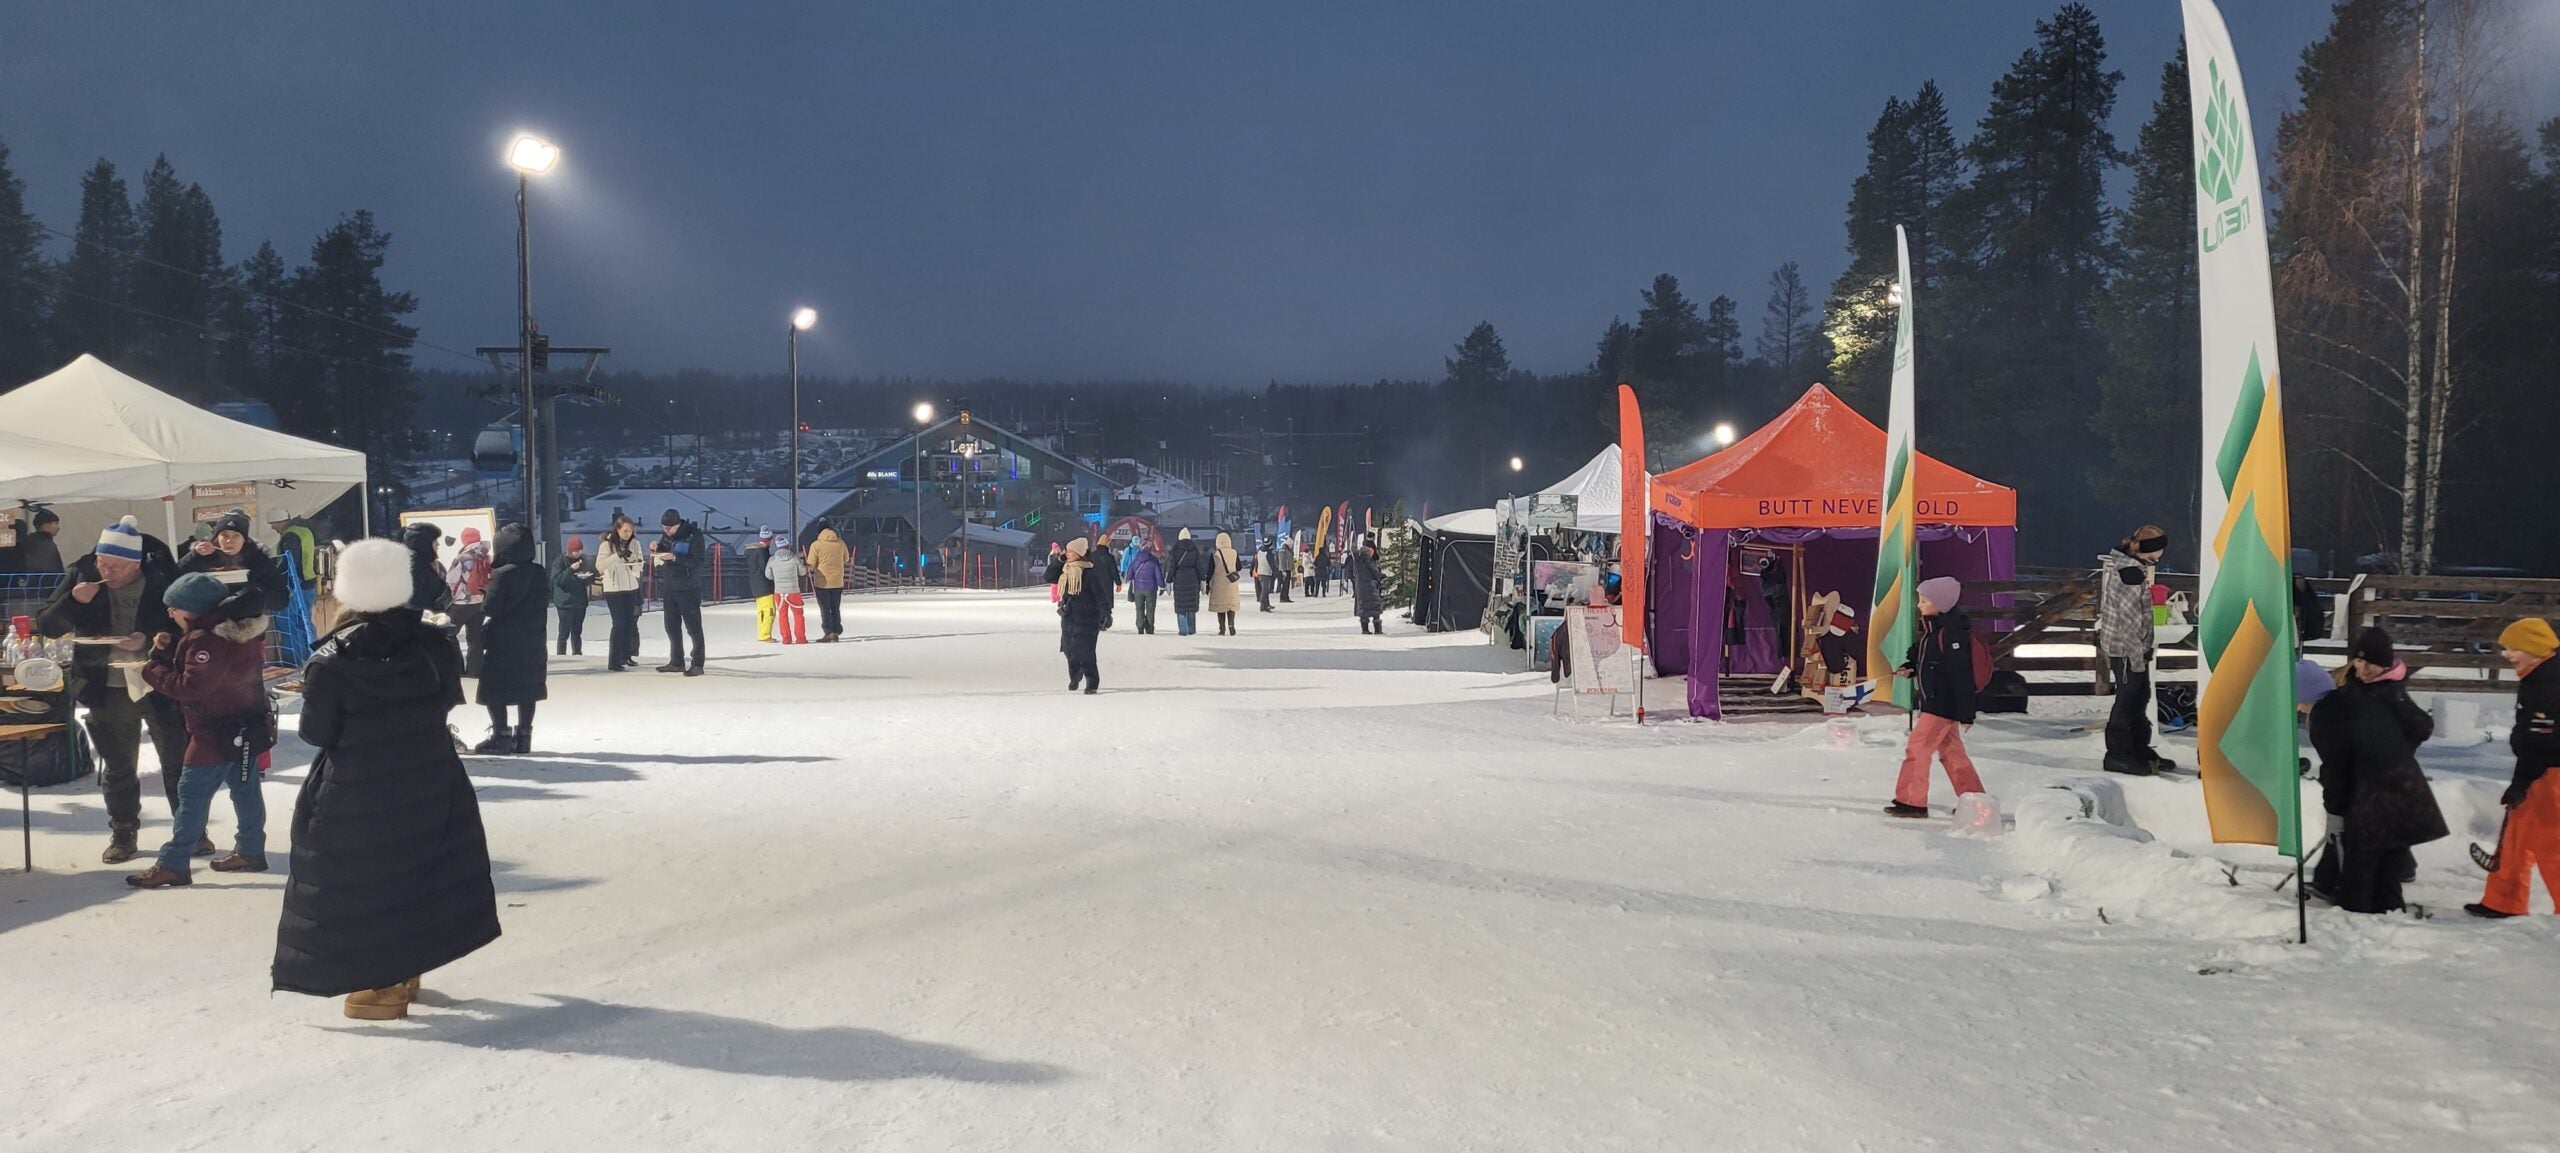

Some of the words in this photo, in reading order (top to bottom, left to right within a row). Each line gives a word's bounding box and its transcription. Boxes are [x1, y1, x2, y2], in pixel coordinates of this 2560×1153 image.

[950, 439, 983, 454] Levi.
[1759, 499, 1813, 516] BUTT
[1822, 498, 1879, 515] NEVE
[1916, 500, 1959, 516] OLD
[241, 741, 250, 782] marimekko
